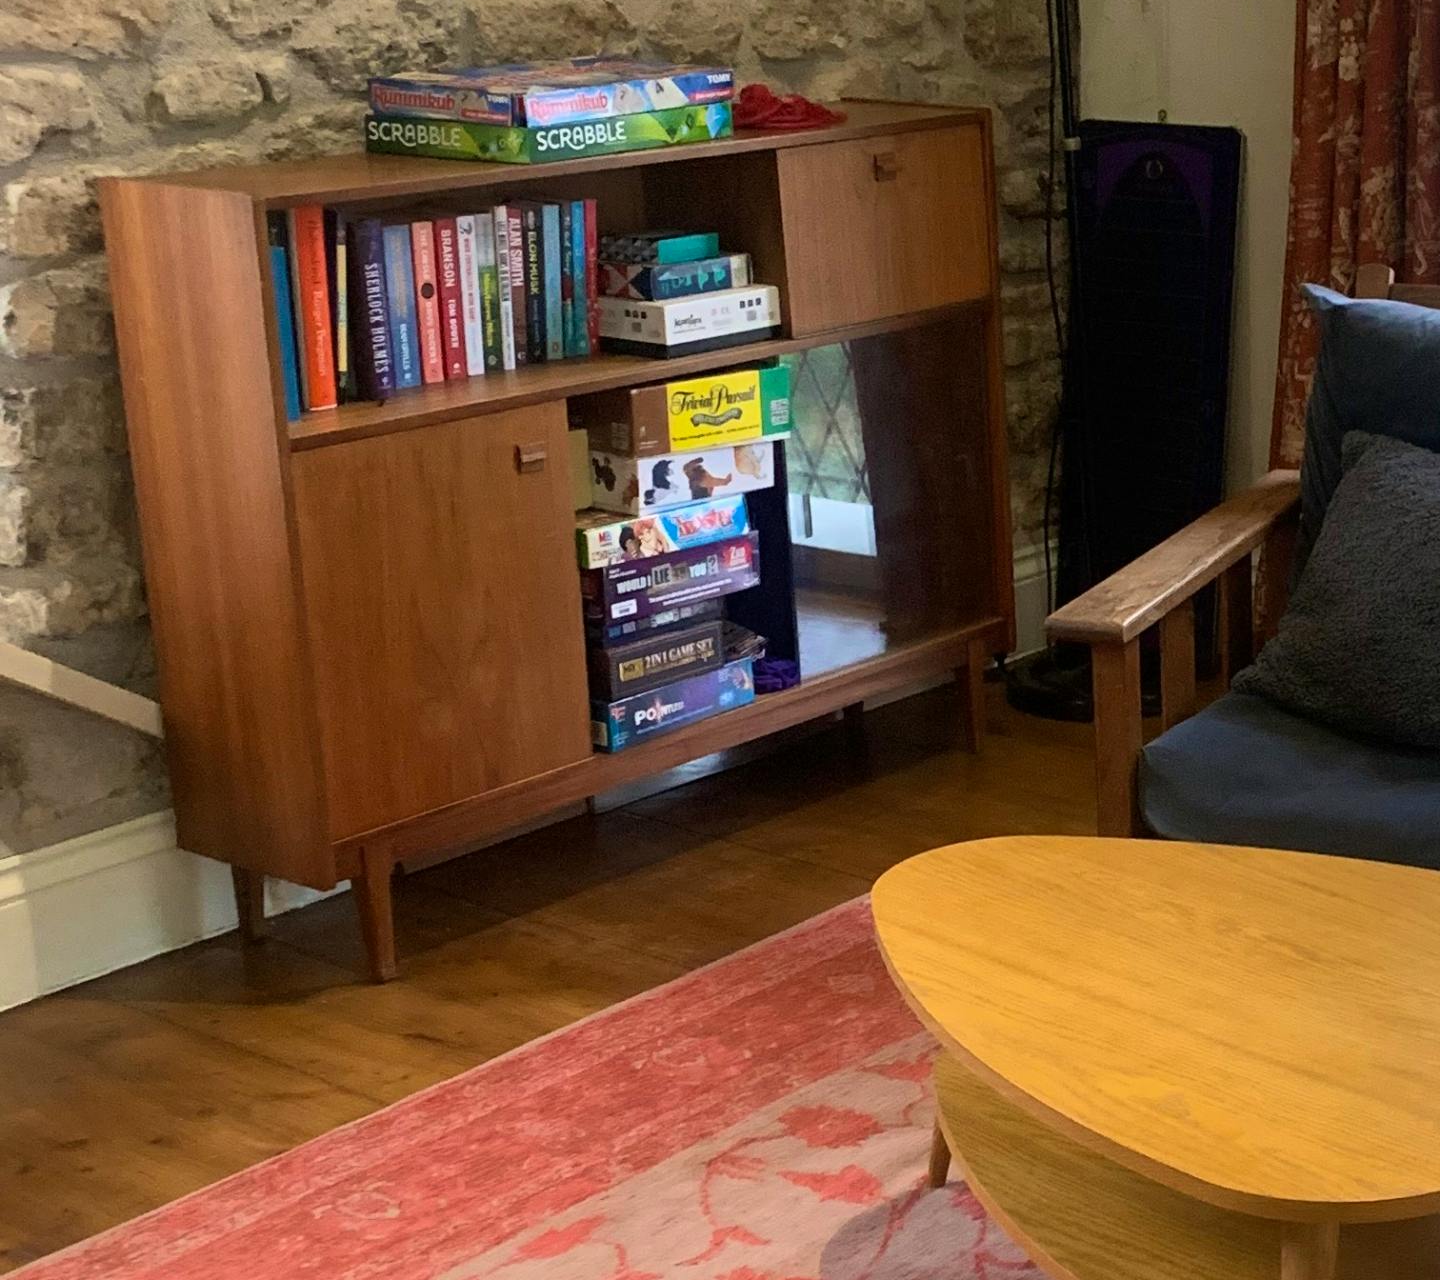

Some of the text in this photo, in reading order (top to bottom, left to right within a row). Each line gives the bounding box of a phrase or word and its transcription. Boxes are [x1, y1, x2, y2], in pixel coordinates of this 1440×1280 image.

[707, 73, 731, 84] TOMY
[530, 92, 608, 120] Rummikub
[368, 121, 461, 147] SCRABBLE
[536, 121, 627, 151] SCRABBLE
[441, 229, 456, 287] BRANSON
[508, 218, 524, 286] ALAN SMITH
[528, 231, 537, 261] ELON
[530, 263, 539, 294] MUSK
[364, 263, 389, 373] SHERLOCK HOLMES
[670, 391, 713, 415] Trivial
[710, 384, 756, 413] Pursuit
[616, 575, 647, 595] WOULD
[654, 567, 671, 585] LIE
[669, 642, 695, 660] GAME
[696, 638, 714, 653] SET
